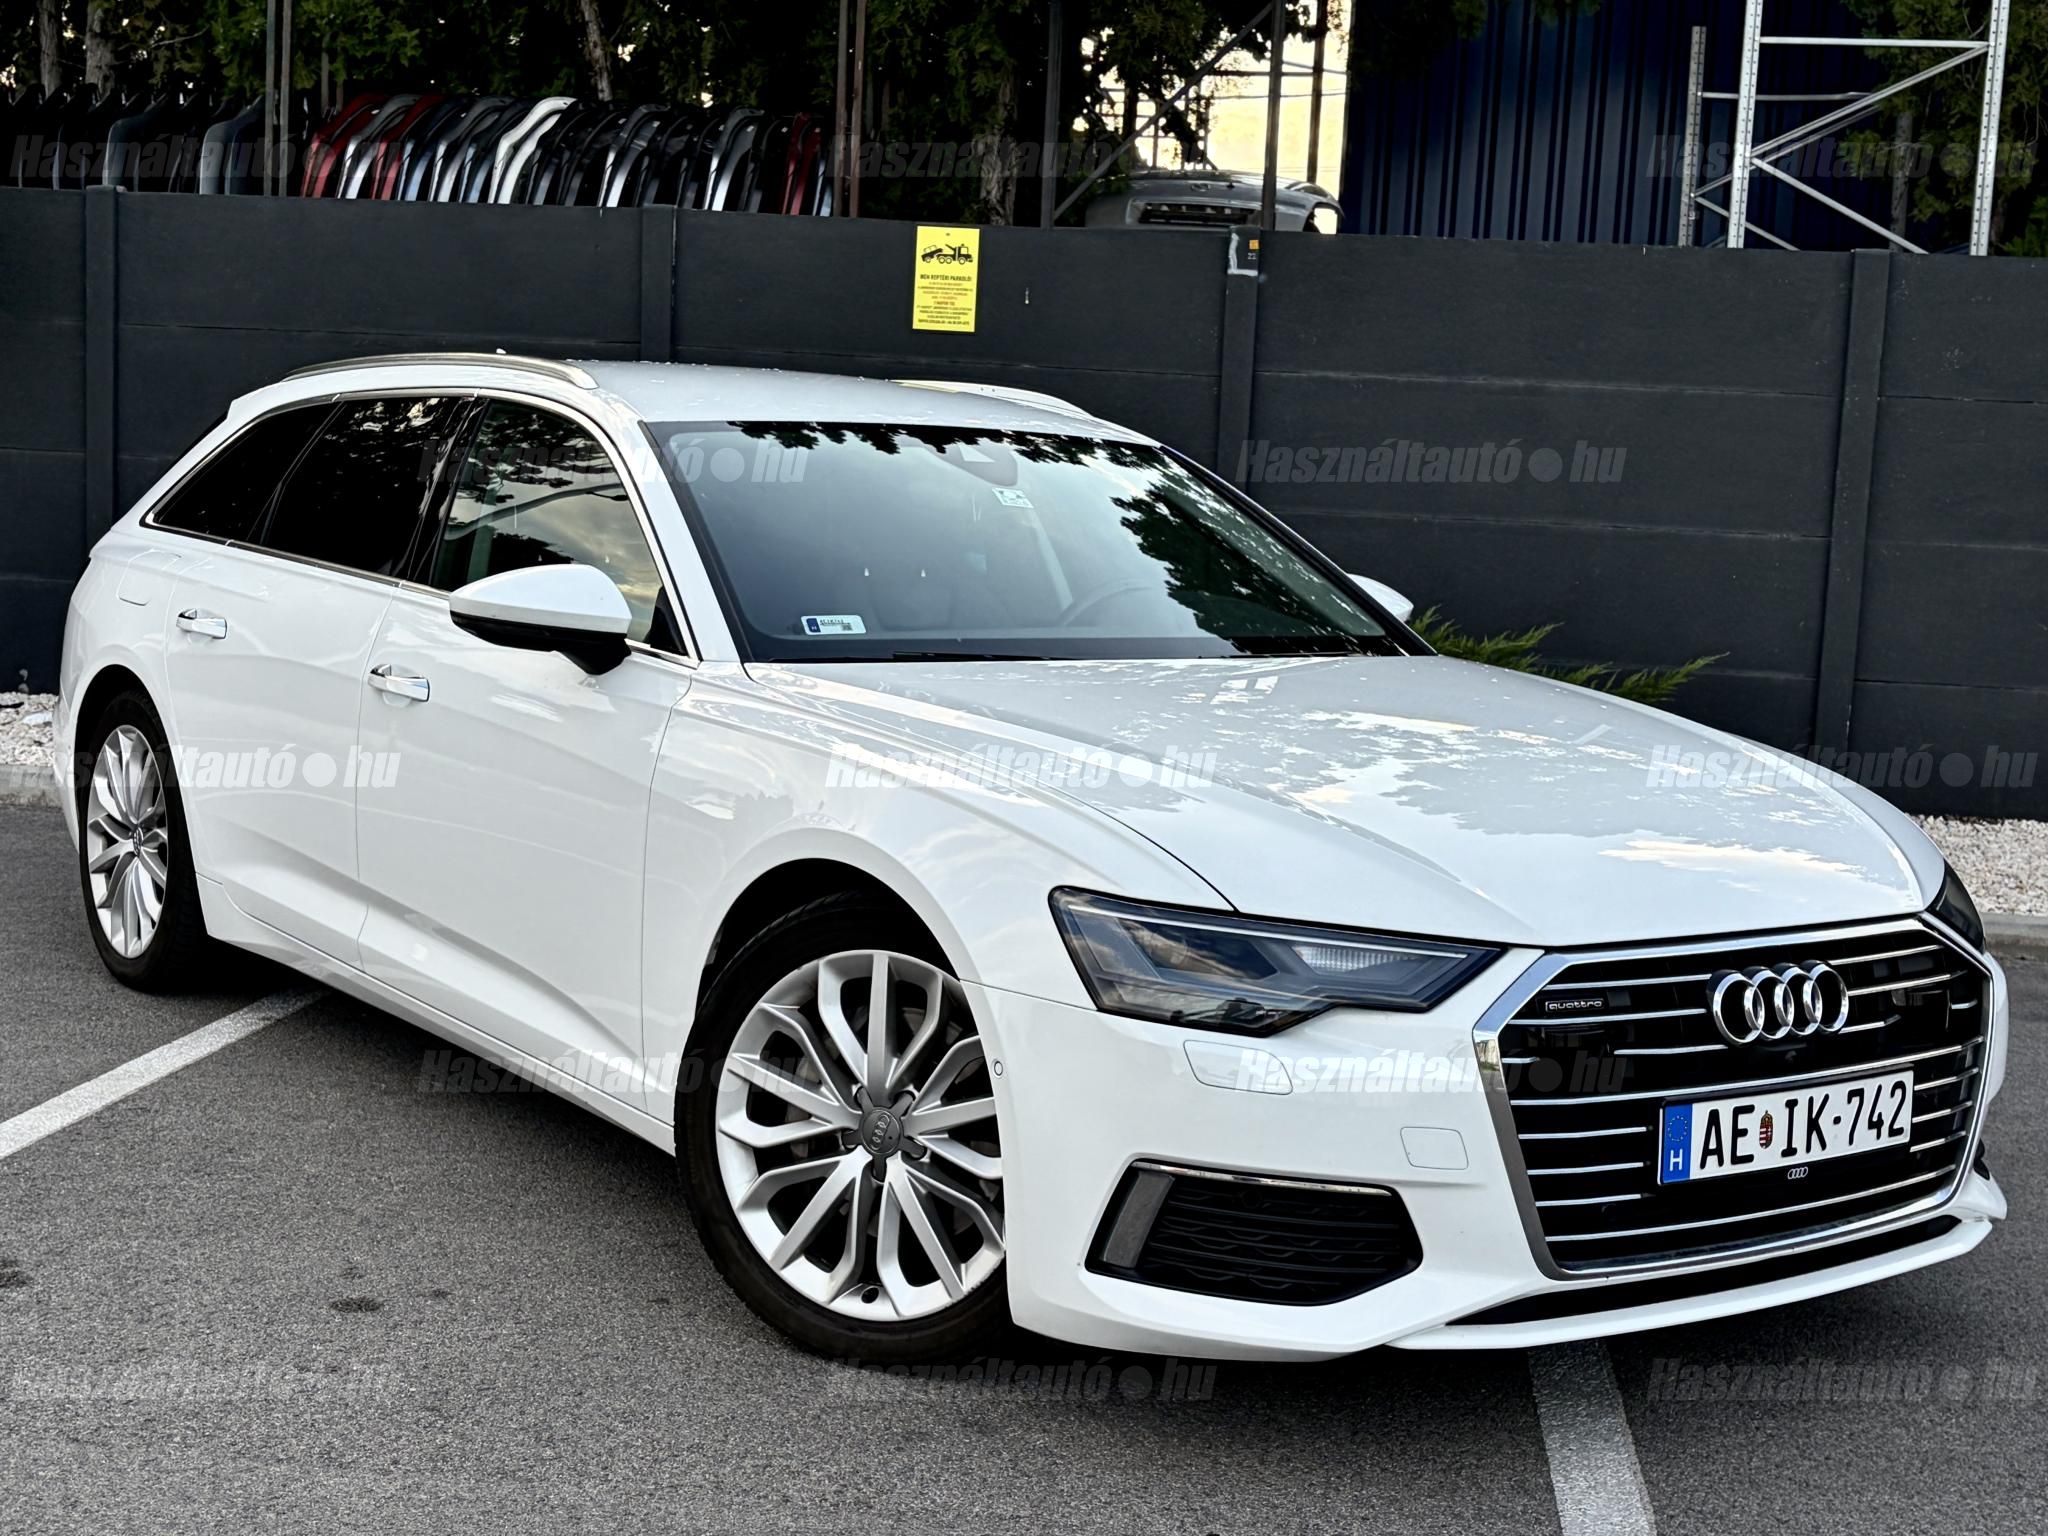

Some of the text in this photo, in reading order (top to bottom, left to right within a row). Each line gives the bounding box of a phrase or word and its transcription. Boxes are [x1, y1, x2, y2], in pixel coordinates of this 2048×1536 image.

[1548, 1000, 1602, 1011] quattro
[1700, 1080, 1907, 1169] AE IK-742
[1669, 1148, 1683, 1171] H
